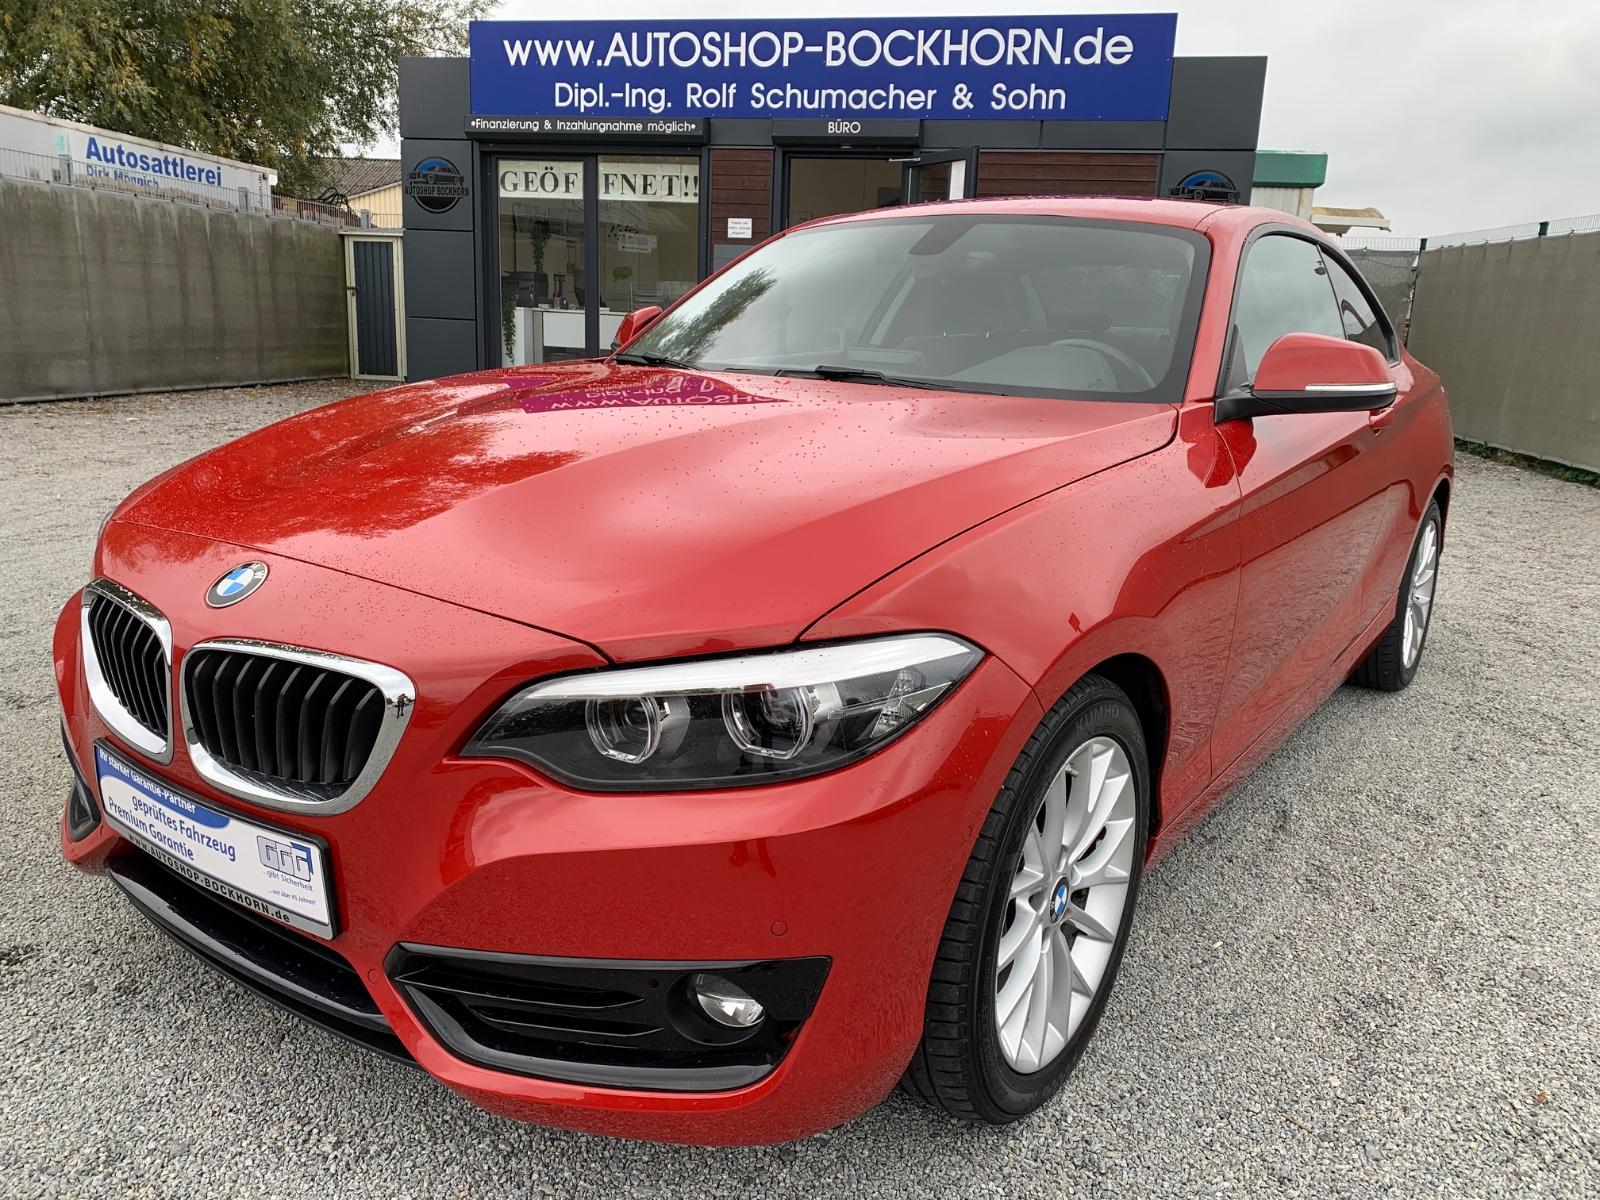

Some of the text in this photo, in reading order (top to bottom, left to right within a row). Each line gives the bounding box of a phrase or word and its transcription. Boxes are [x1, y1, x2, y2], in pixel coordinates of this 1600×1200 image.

[503, 27, 1134, 67] www.AUTOSHOP-BOCKHORN.de
[554, 82, 1067, 113] Dipl.-Ing. Rolf Schumacher & Sohn
[543, 119, 552, 131] &
[556, 119, 643, 133] Inzahlungnahme
[647, 120, 692, 134] möglich
[828, 118, 861, 134] BÜRO
[85, 136, 222, 187] Autosattlerei
[500, 166, 699, 198] GEÖF FNET!!
[1075, 704, 1120, 735] KUMHO
[108, 756, 130, 778] starker
[130, 770, 196, 814] Garantie-Partner
[108, 796, 195, 861] Premium Garantie
[132, 795, 236, 861] geprüftes Fahrzeug
